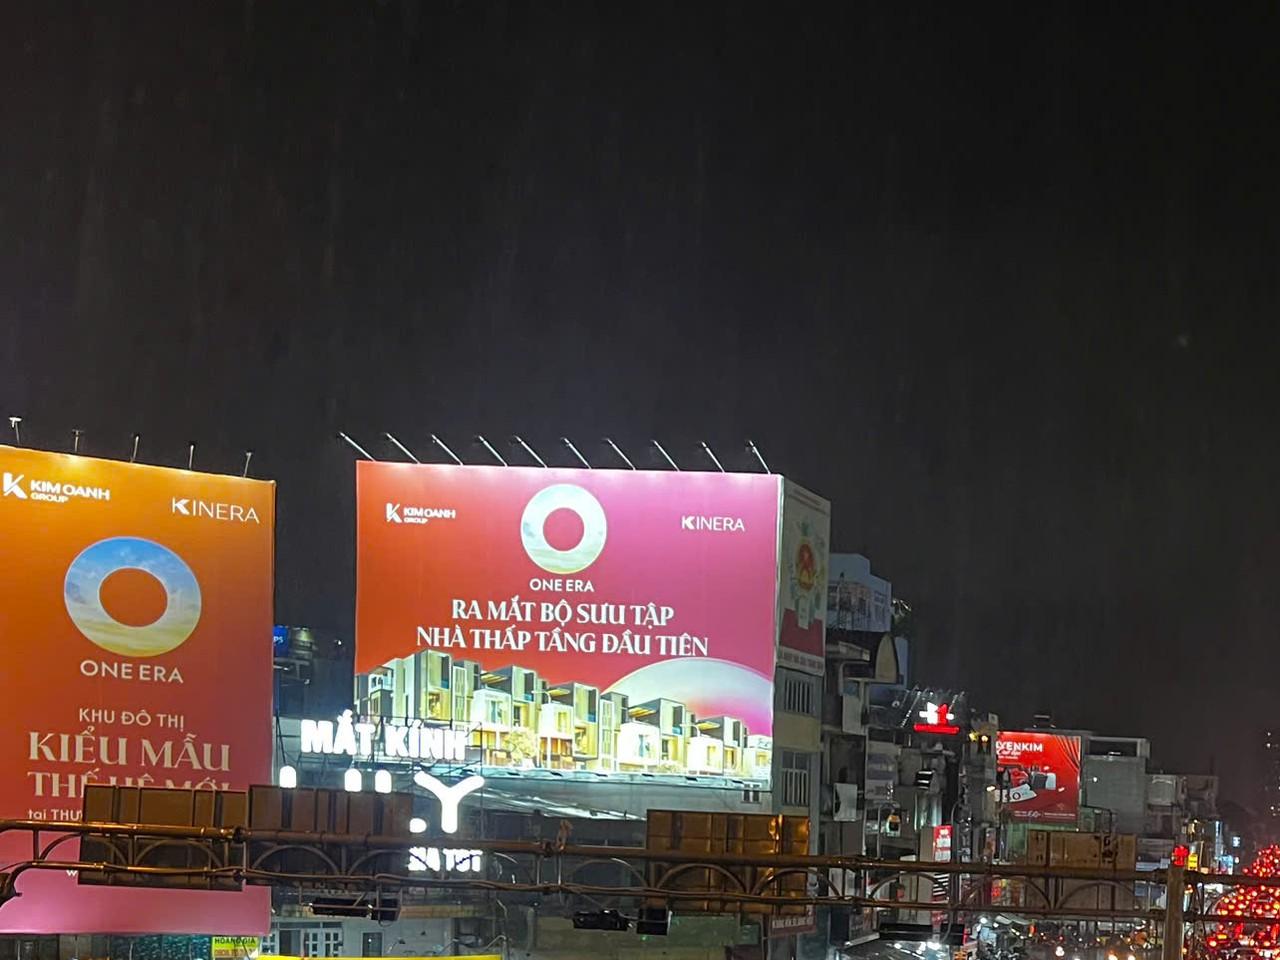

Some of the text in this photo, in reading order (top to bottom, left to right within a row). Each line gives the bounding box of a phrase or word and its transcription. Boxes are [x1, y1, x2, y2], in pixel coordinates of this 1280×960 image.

[30, 479, 110, 501] KIM OANH
[30, 492, 69, 504] GROUP
[172, 497, 260, 525] KINERA
[403, 507, 457, 520] KIM OANH
[681, 515, 746, 533] KINERA
[529, 577, 595, 593] ONE ERA
[451, 595, 674, 630] RA MẮT BỘ SƯU TẬP
[416, 623, 709, 657] NHÀ THẤP TẦNG ĐẦU TIÊN
[80, 659, 184, 684] ONE ERA
[79, 708, 185, 732] KHU ĐÔ THỊ
[28, 725, 231, 772] KIỂU MẪU
